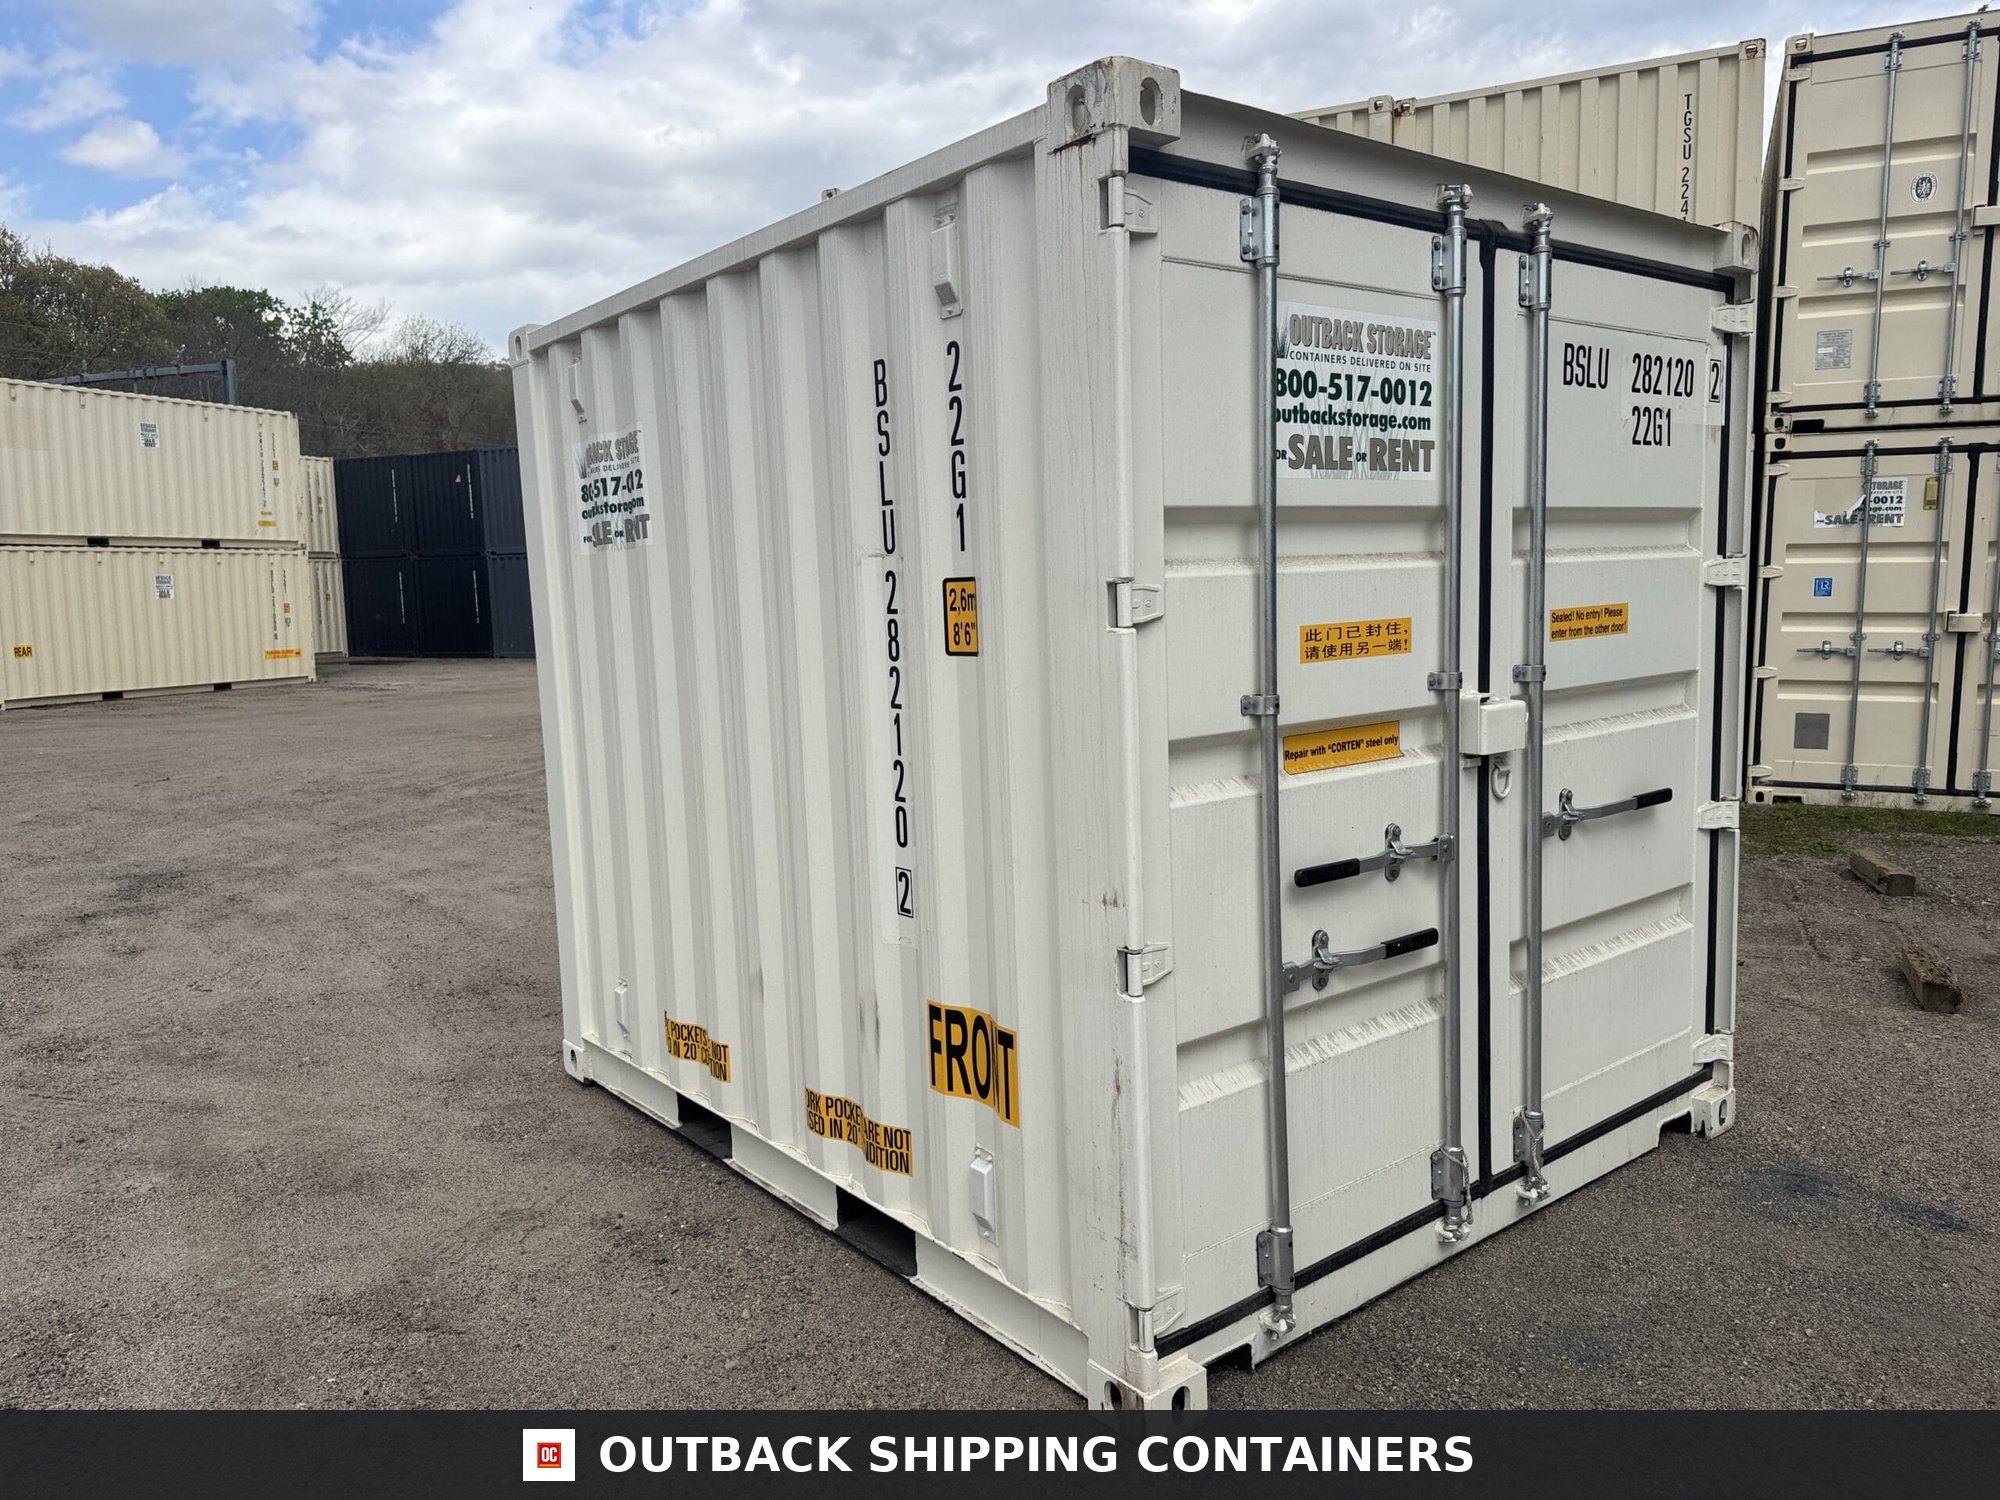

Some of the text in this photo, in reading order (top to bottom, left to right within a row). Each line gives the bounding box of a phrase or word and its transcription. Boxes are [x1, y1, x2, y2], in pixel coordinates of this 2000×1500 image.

[1680, 93, 1693, 220] TGSU 224
[1289, 313, 1364, 353] OUTBACK
[1289, 350, 1431, 373] CONTAINERS DELIVERED ON SITE
[1563, 342, 1720, 401] BSLU 282120 2
[1631, 405, 1672, 447] 22G1
[945, 340, 967, 552] 22G1
[1288, 434, 1353, 470] SALE
[1356, 452, 1367, 463] OR
[1369, 437, 1435, 472] RENT
[614, 530, 624, 538] OR
[1551, 607, 1623, 624] Sealed! No entry! Please
[1551, 621, 1627, 640] enter from the other door!
[873, 358, 913, 916] BSLU 282120 2
[1284, 747, 1308, 762] Repair
[1311, 745, 1326, 755] with
[1366, 736, 1383, 748] steel
[1384, 734, 1399, 746] only
[807, 1109, 825, 1136] SED
[829, 1118, 843, 1139] IN
[883, 1127, 911, 1152] NOT
